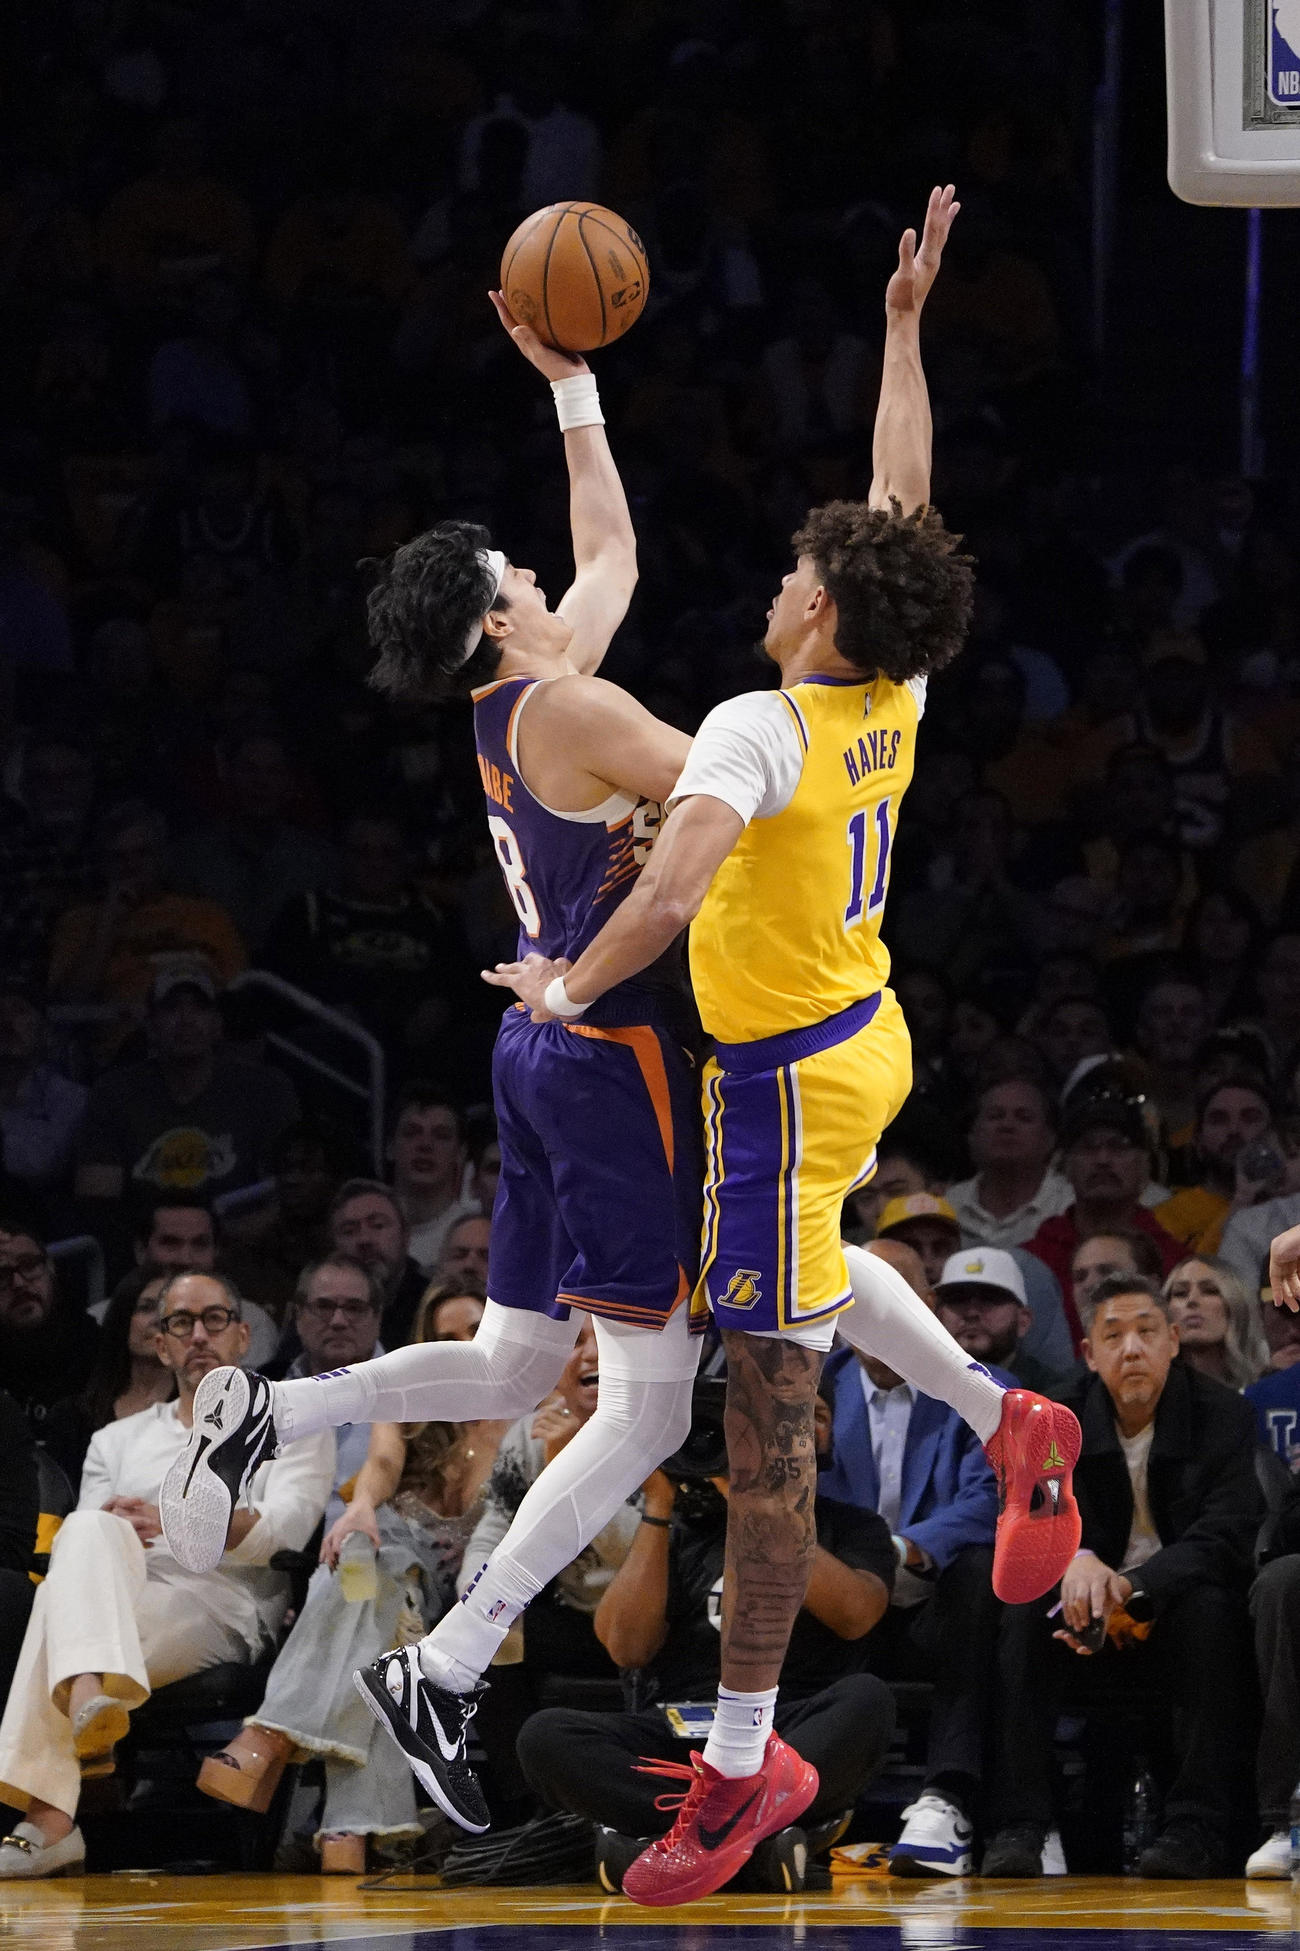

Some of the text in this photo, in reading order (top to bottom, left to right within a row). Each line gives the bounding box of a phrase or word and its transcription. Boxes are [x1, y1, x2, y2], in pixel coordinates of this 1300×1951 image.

[1278, 71, 1300, 95] NB
[843, 729, 901, 787] HAYES
[844, 795, 892, 931] 11
